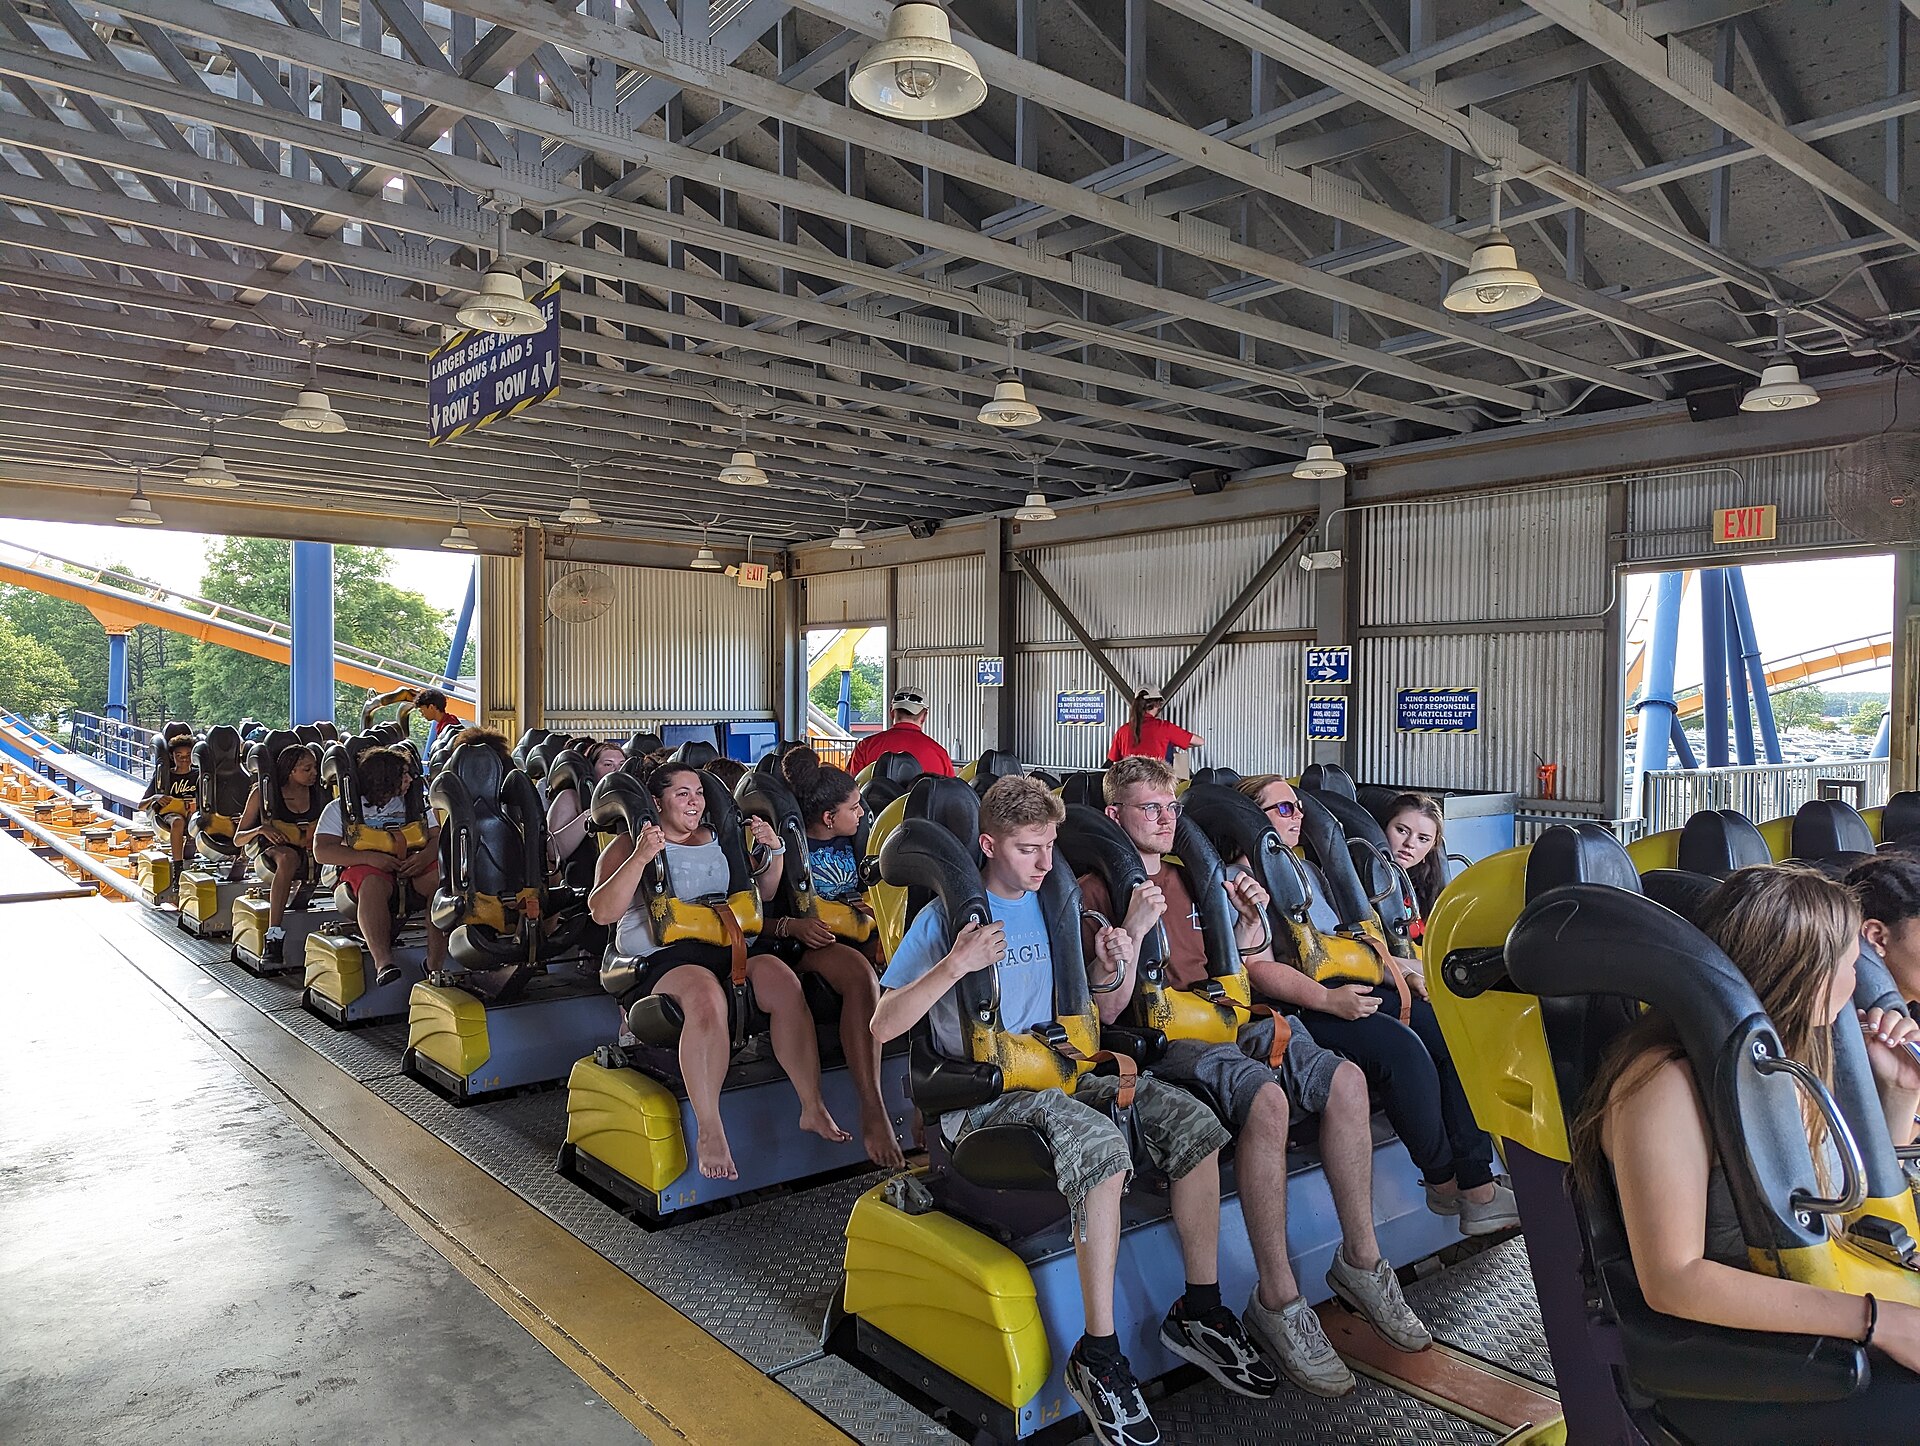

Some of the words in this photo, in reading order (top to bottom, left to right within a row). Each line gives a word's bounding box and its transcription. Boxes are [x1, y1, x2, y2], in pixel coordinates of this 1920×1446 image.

[432, 351, 466, 380] LARGER
[467, 333, 495, 362] SEATS
[447, 376, 457, 395] IN
[459, 361, 487, 389] ROWS
[490, 356, 497, 373] 4
[500, 344, 522, 370] AND
[526, 338, 533, 357] 5
[495, 369, 527, 405] ROW
[531, 364, 540, 388] 4
[442, 395, 469, 428] ROW
[472, 391, 480, 415] 5
[1724, 507, 1765, 538] EXIT
[746, 565, 764, 581] EXIT
[978, 661, 1002, 673] EXIT
[1309, 652, 1348, 666] EXIT
[170, 779, 197, 795] Nike
[1041, 1398, 1061, 1425] 1-2
